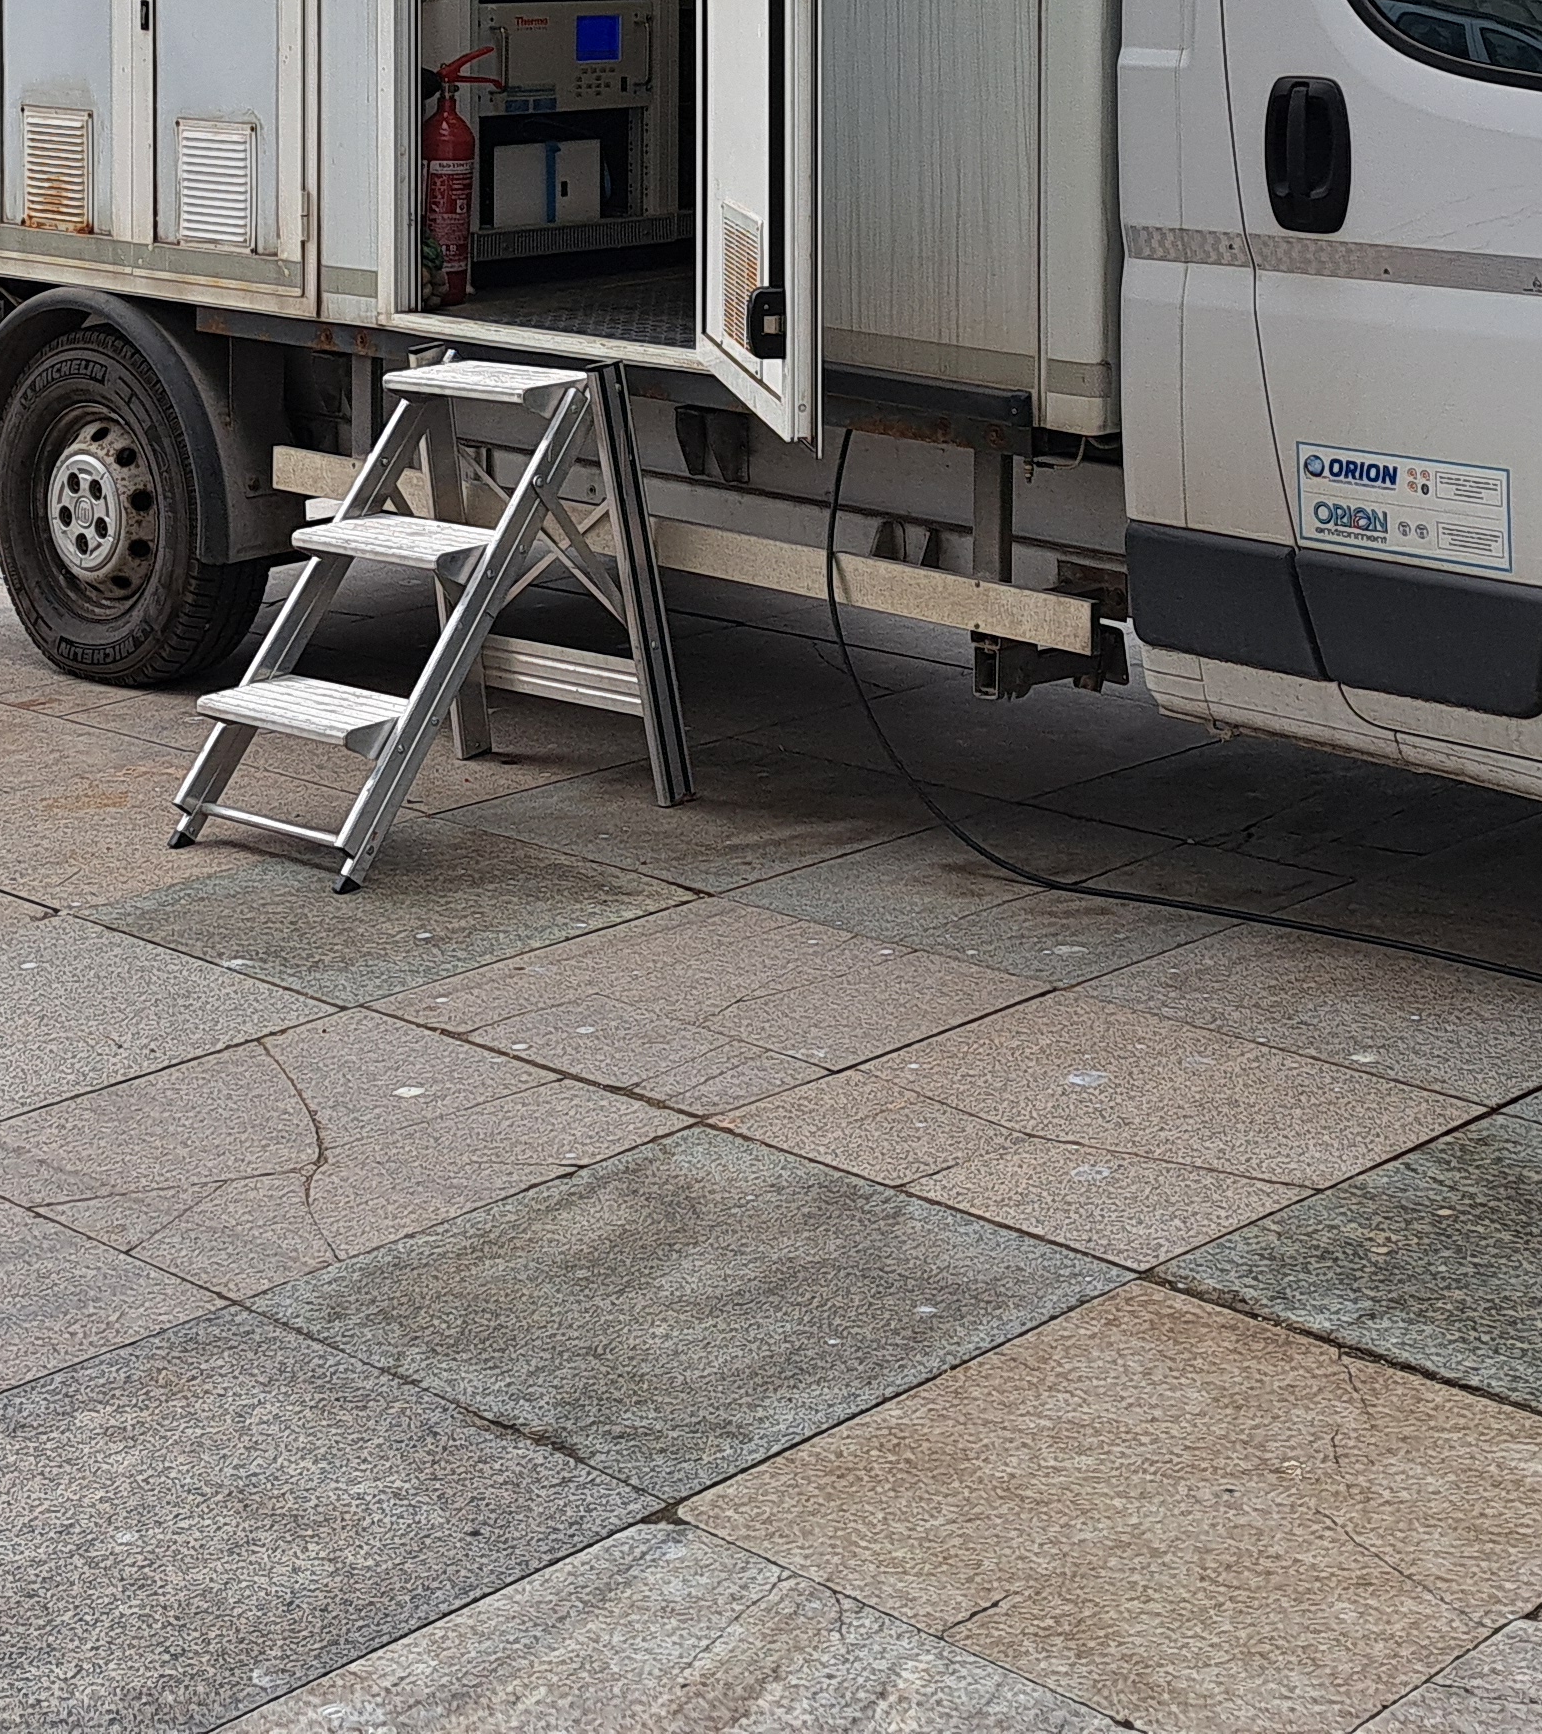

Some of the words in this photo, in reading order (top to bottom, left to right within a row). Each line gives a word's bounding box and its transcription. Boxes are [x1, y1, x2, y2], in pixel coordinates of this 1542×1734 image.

[35, 358, 108, 393] MICHELIN
[1328, 458, 1399, 485] ORION
[1313, 501, 1389, 534] ORION
[1315, 527, 1388, 544] environment
[59, 634, 136, 665] MICHELIN
